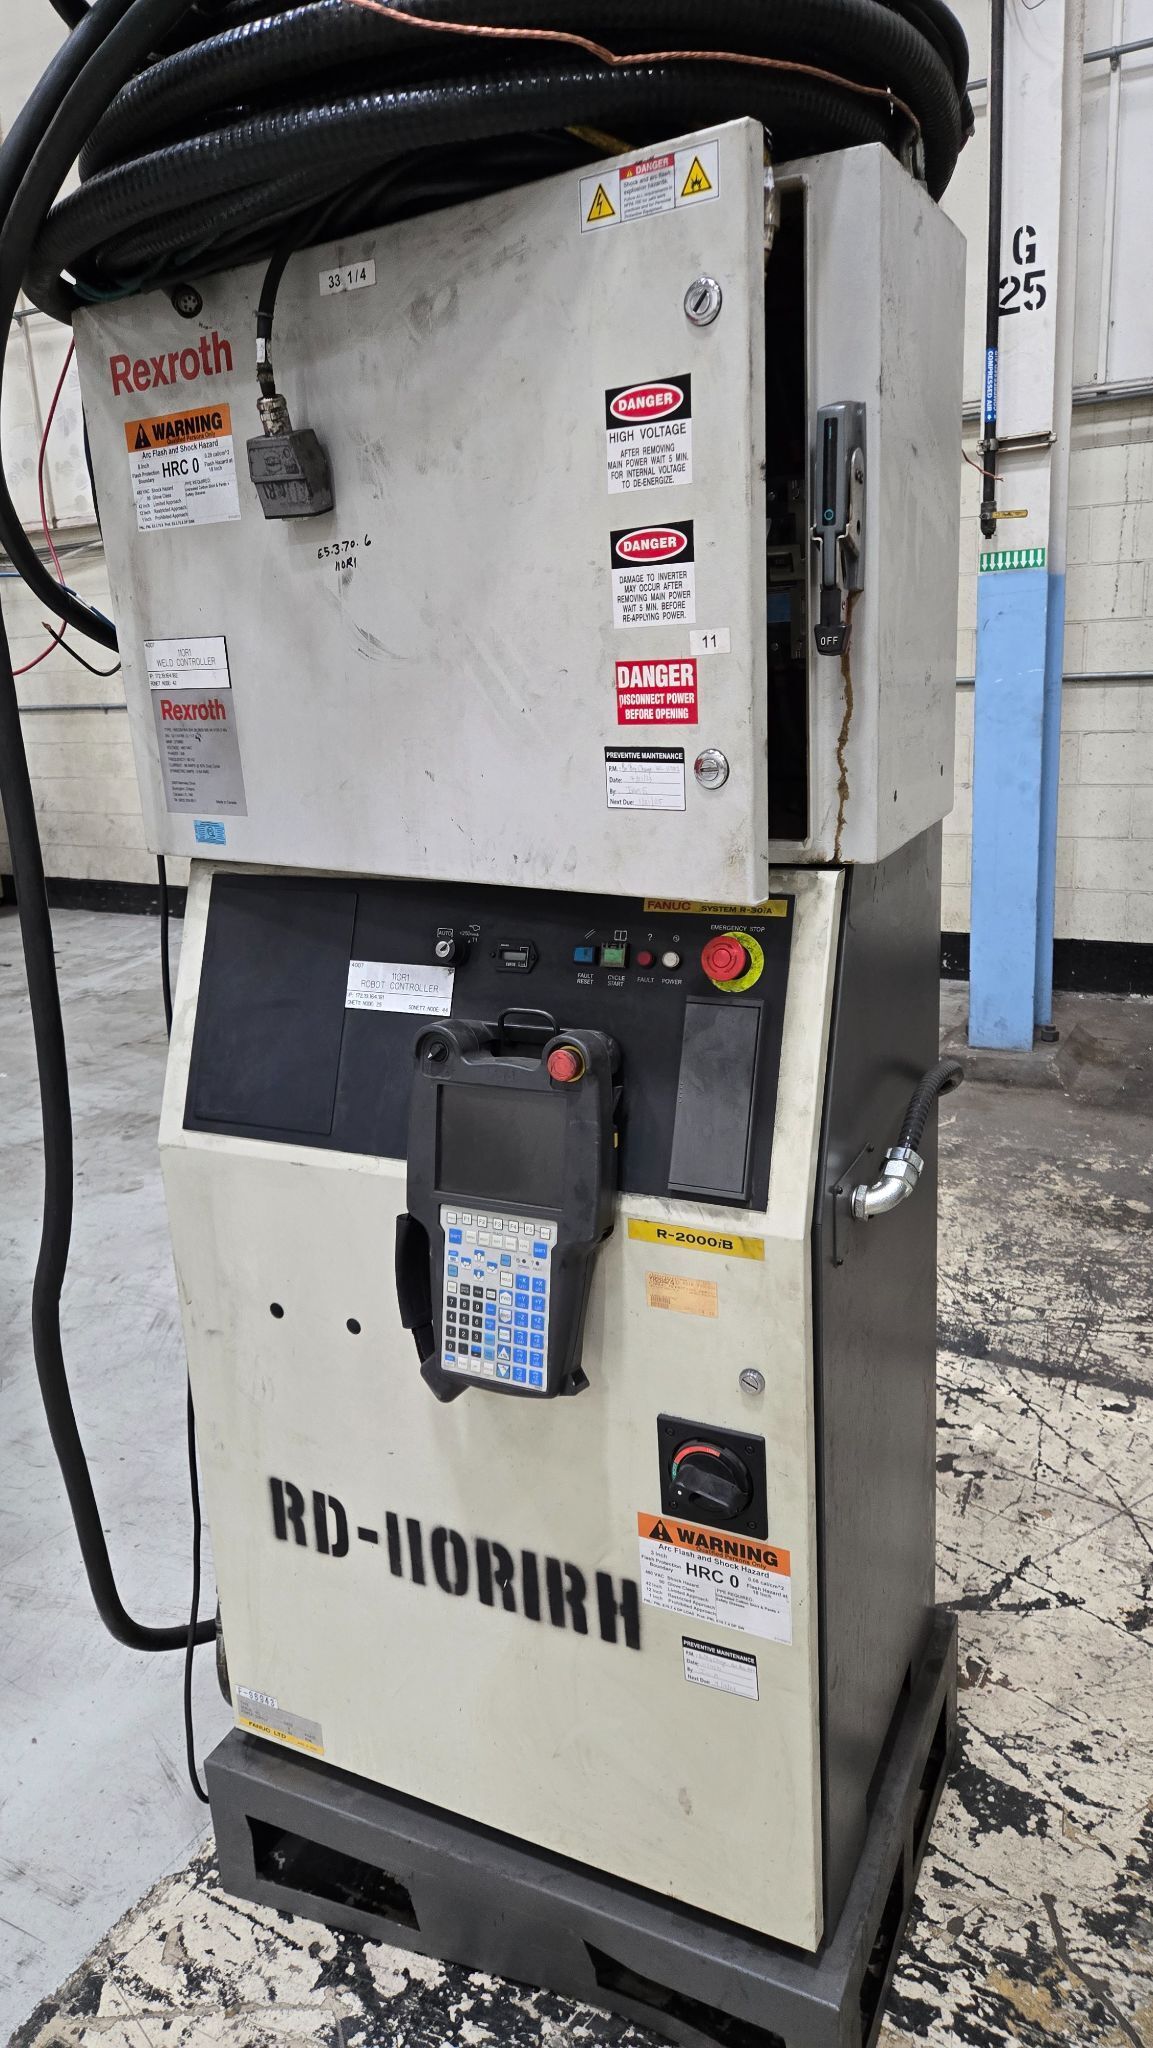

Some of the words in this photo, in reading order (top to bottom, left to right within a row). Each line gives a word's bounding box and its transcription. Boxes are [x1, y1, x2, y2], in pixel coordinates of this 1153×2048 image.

[636, 157, 669, 175] DANGER
[1012, 225, 1036, 265] G
[328, 274, 342, 289] 33
[347, 267, 367, 285] 1/4
[998, 269, 1047, 317] 25
[110, 331, 233, 396] Rexroth
[618, 392, 673, 412] DANGER
[152, 412, 222, 441] WARNING
[609, 430, 634, 444] HIGH
[640, 422, 687, 440] VOLTAGE
[142, 451, 151, 459] Arc
[153, 449, 168, 458] Flash
[169, 447, 178, 455] and
[180, 444, 197, 454] Shock
[199, 440, 219, 449] Hazard
[620, 448, 639, 458] AFTER
[643, 443, 675, 456] REMOVING
[162, 459, 189, 478] HRC
[192, 458, 200, 473] 0
[607, 460, 623, 470] MAIN
[626, 457, 648, 467] POWER
[651, 455, 665, 465] WAIT
[668, 454, 673, 462] 5
[676, 452, 688, 461] MIN.
[611, 471, 623, 480] FOR
[627, 467, 655, 478] INTERNAL
[658, 463, 686, 475] VOLTAGE
[622, 480, 630, 489] TO
[633, 475, 675, 488] DE-ENERGIZE.
[623, 536, 677, 552] DANGER
[619, 574, 643, 584] DAMAGE
[647, 573, 655, 581] TO
[658, 570, 688, 580] INVERTER
[624, 584, 636, 593] MAY
[640, 582, 660, 592] OCCUR
[663, 581, 683, 590] AFTER
[617, 593, 648, 603] REMOVING
[651, 592, 666, 601] MAIN
[669, 590, 691, 600] POWER
[622, 604, 637, 613] WAIT
[645, 603, 659, 611] MIN.
[661, 601, 686, 610] BEFORE
[622, 612, 660, 623] RE-APPLYING
[663, 610, 687, 620] POWER.
[702, 634, 717, 648] 11
[820, 635, 838, 646] OFF
[157, 659, 174, 667] WELD
[176, 657, 216, 667] CONTROLLER
[617, 663, 694, 689] DANGER
[620, 693, 665, 706] DISCONNECT
[666, 692, 695, 704] POWER
[160, 699, 226, 721] Rexroth
[625, 708, 654, 720] BEFORE
[656, 707, 689, 719] OPENING
[606, 751, 641, 759] PREVENTIVE
[641, 752, 683, 760] MAINTENANCE
[647, 900, 691, 911] FANUC
[701, 905, 737, 913] SYSTEM
[361, 980, 386, 989] ROBOT
[389, 982, 439, 993] CONTROLLER
[656, 1228, 734, 1250] R-2000iB
[677, 1528, 778, 1567] WARNING
[650, 1562, 674, 1573] Boundary
[656, 1559, 681, 1569] Protection
[659, 1544, 672, 1552] Arc
[675, 1547, 695, 1558] Flash
[697, 1555, 712, 1563] and
[714, 1558, 739, 1570] Shock
[741, 1565, 770, 1579] Hazard
[752, 1561, 767, 1570] Only
[686, 1562, 723, 1583] HRC
[730, 1575, 739, 1588] 0
[747, 1583, 761, 1592] Flash
[762, 1588, 781, 1597] Hazard
[683, 1639, 716, 1654] PREVENTIVE
[716, 1649, 755, 1664] MAINTENANCE
[248, 1721, 271, 1733] FANUC
[273, 1730, 287, 1739] LTD
